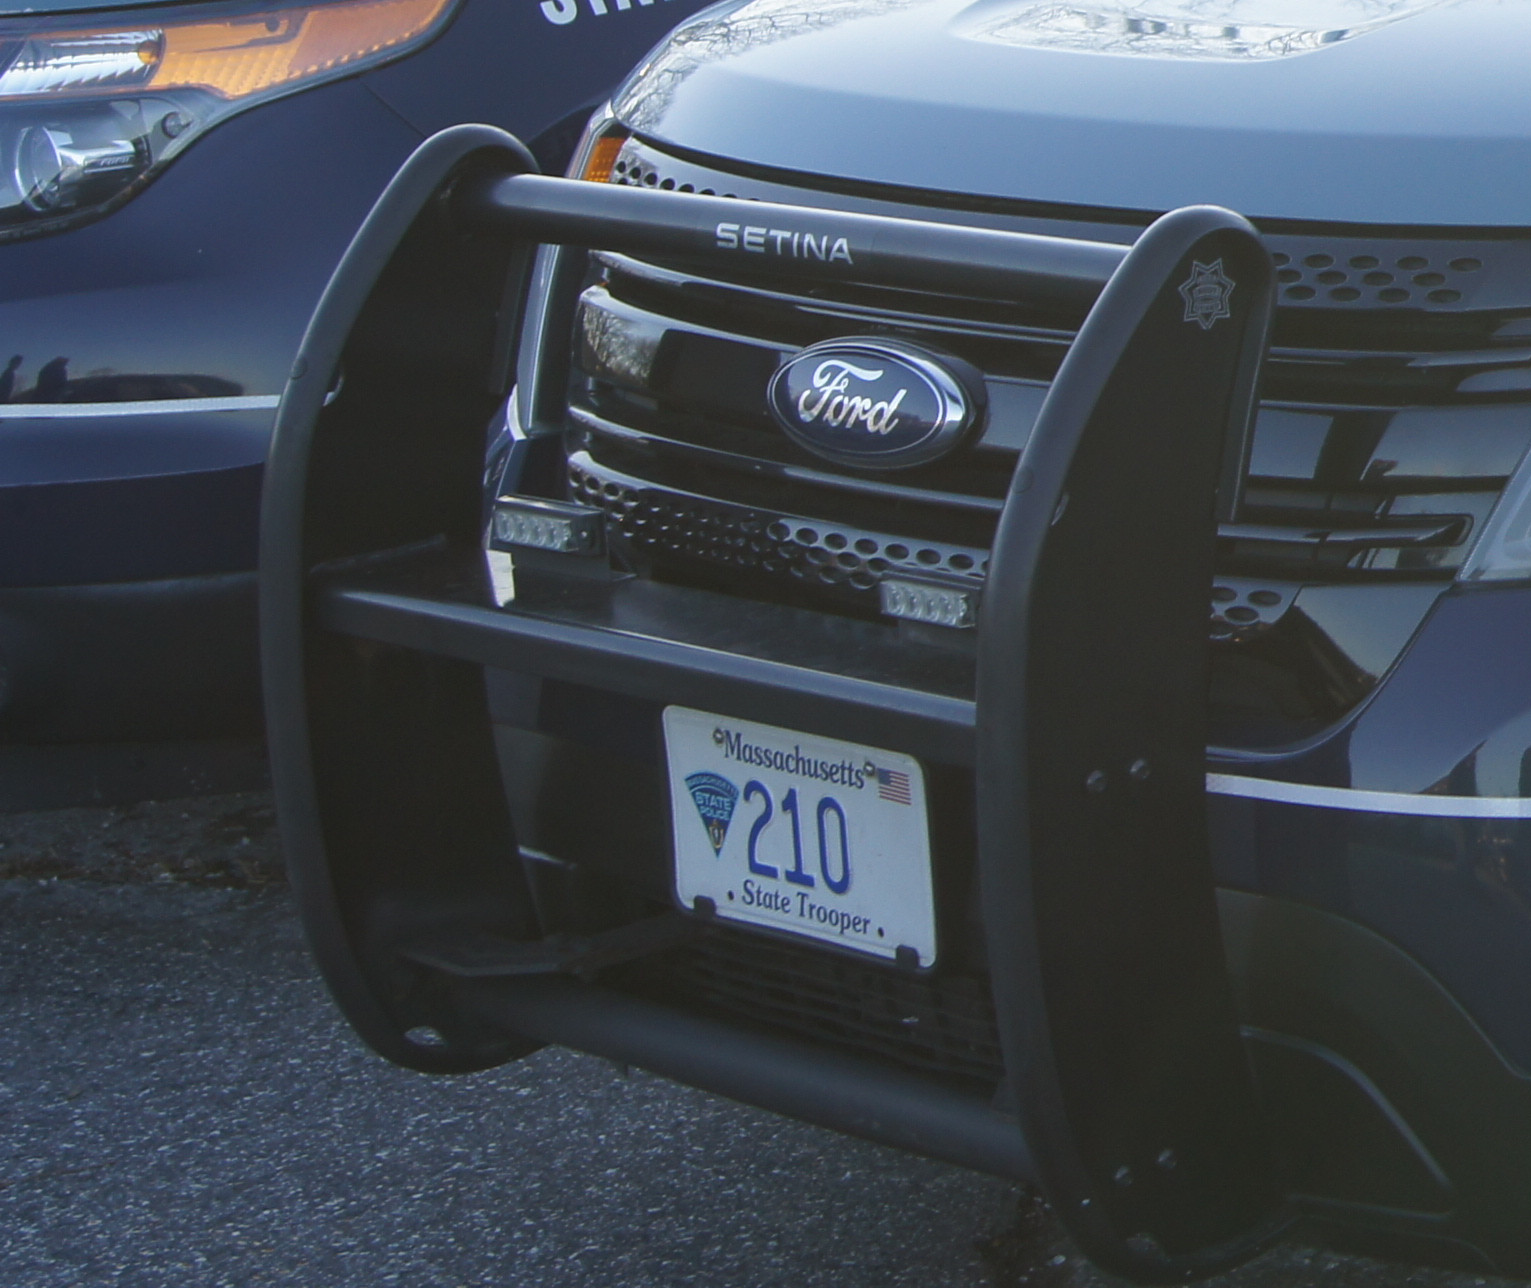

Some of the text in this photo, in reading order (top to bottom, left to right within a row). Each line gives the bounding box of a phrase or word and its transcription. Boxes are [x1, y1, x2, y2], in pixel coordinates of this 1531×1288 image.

[715, 222, 854, 265] SETINA
[798, 359, 908, 436] Ford
[722, 728, 866, 791] Massachusetts
[695, 791, 732, 811] STATE
[743, 779, 851, 896] 210
[742, 879, 871, 935] State Trooper
